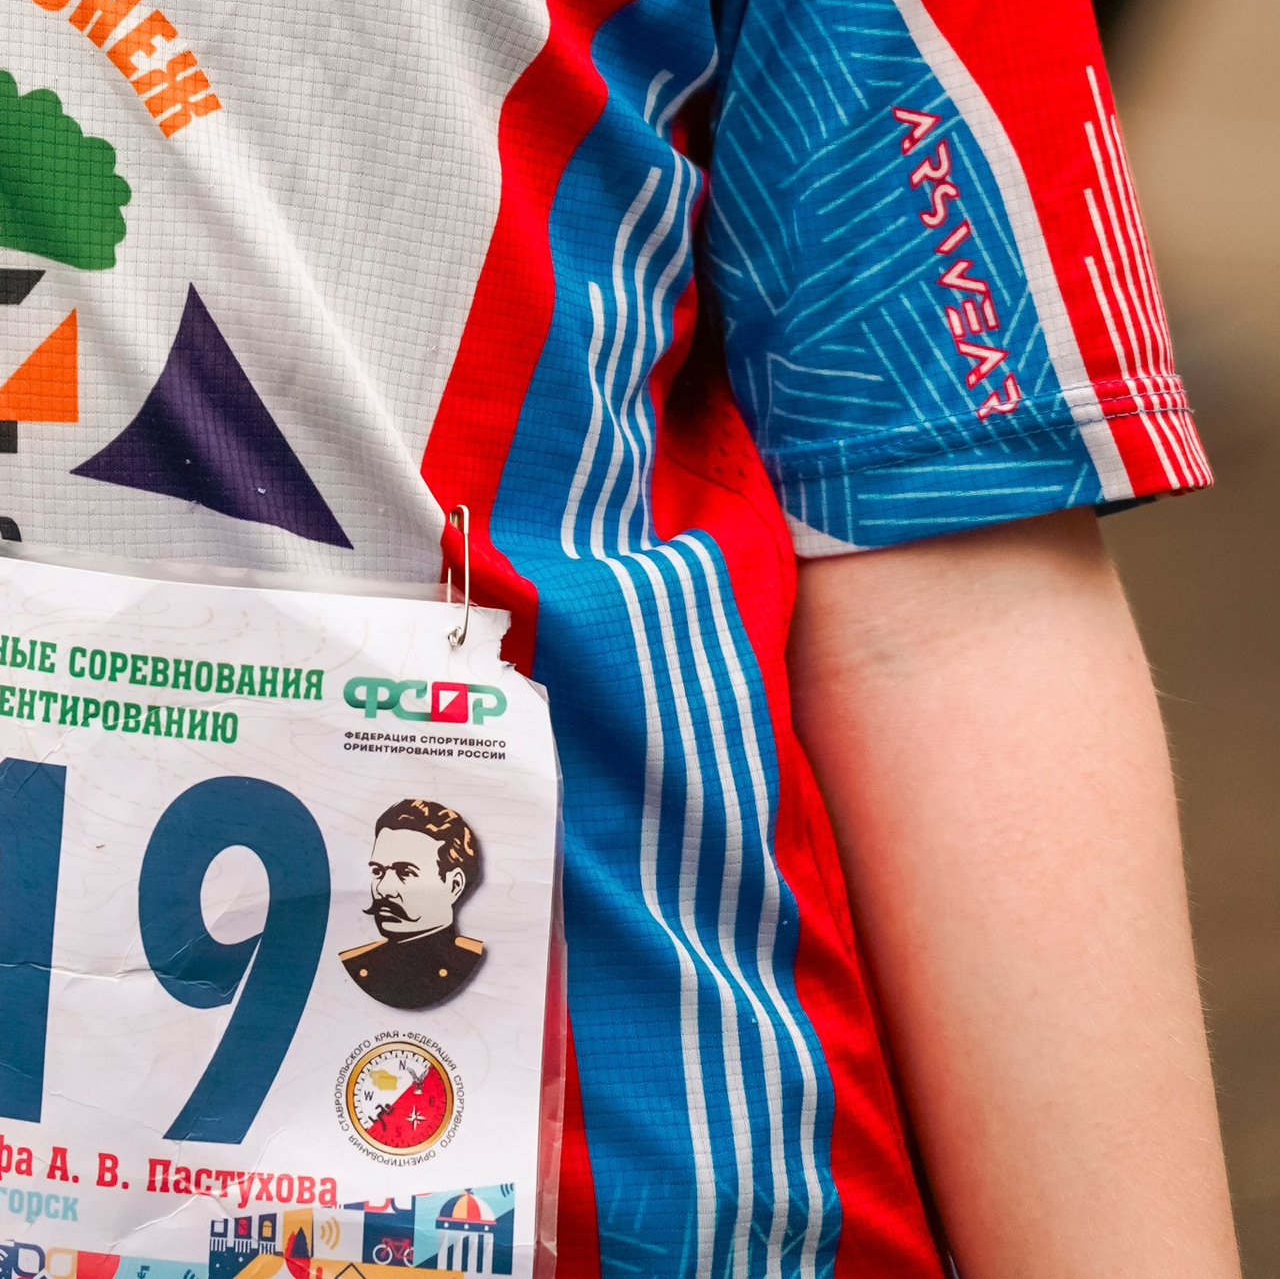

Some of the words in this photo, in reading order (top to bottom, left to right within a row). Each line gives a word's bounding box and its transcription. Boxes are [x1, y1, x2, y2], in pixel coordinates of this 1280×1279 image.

[68, 647, 325, 702] СОРЕВНОВАНИЯ
[343, 742, 454, 757] ОРИЕНТИРОВАНИЯ
[457, 749, 507, 760] РОССИИ
[344, 731, 417, 744] ФЕДЕРАЦИЯ
[420, 735, 507, 749] СПОРТИВНОГО
[374, 1030, 400, 1042] КРАЯ
[406, 1031, 457, 1072] ФЕДЕРАЦИЯ
[398, 1059, 407, 1071] N
[334, 1039, 372, 1132] СТАВРОПОЛЬСКОГО
[363, 1091, 374, 1101] W
[440, 1074, 465, 1149] СПОРТИВНОГО
[348, 1134, 437, 1167] ОРИЕНТИРОВАНИЯ
[47, 1147, 81, 1184] А.
[96, 1152, 131, 1190] В.
[147, 1158, 339, 1210] Пастухова
